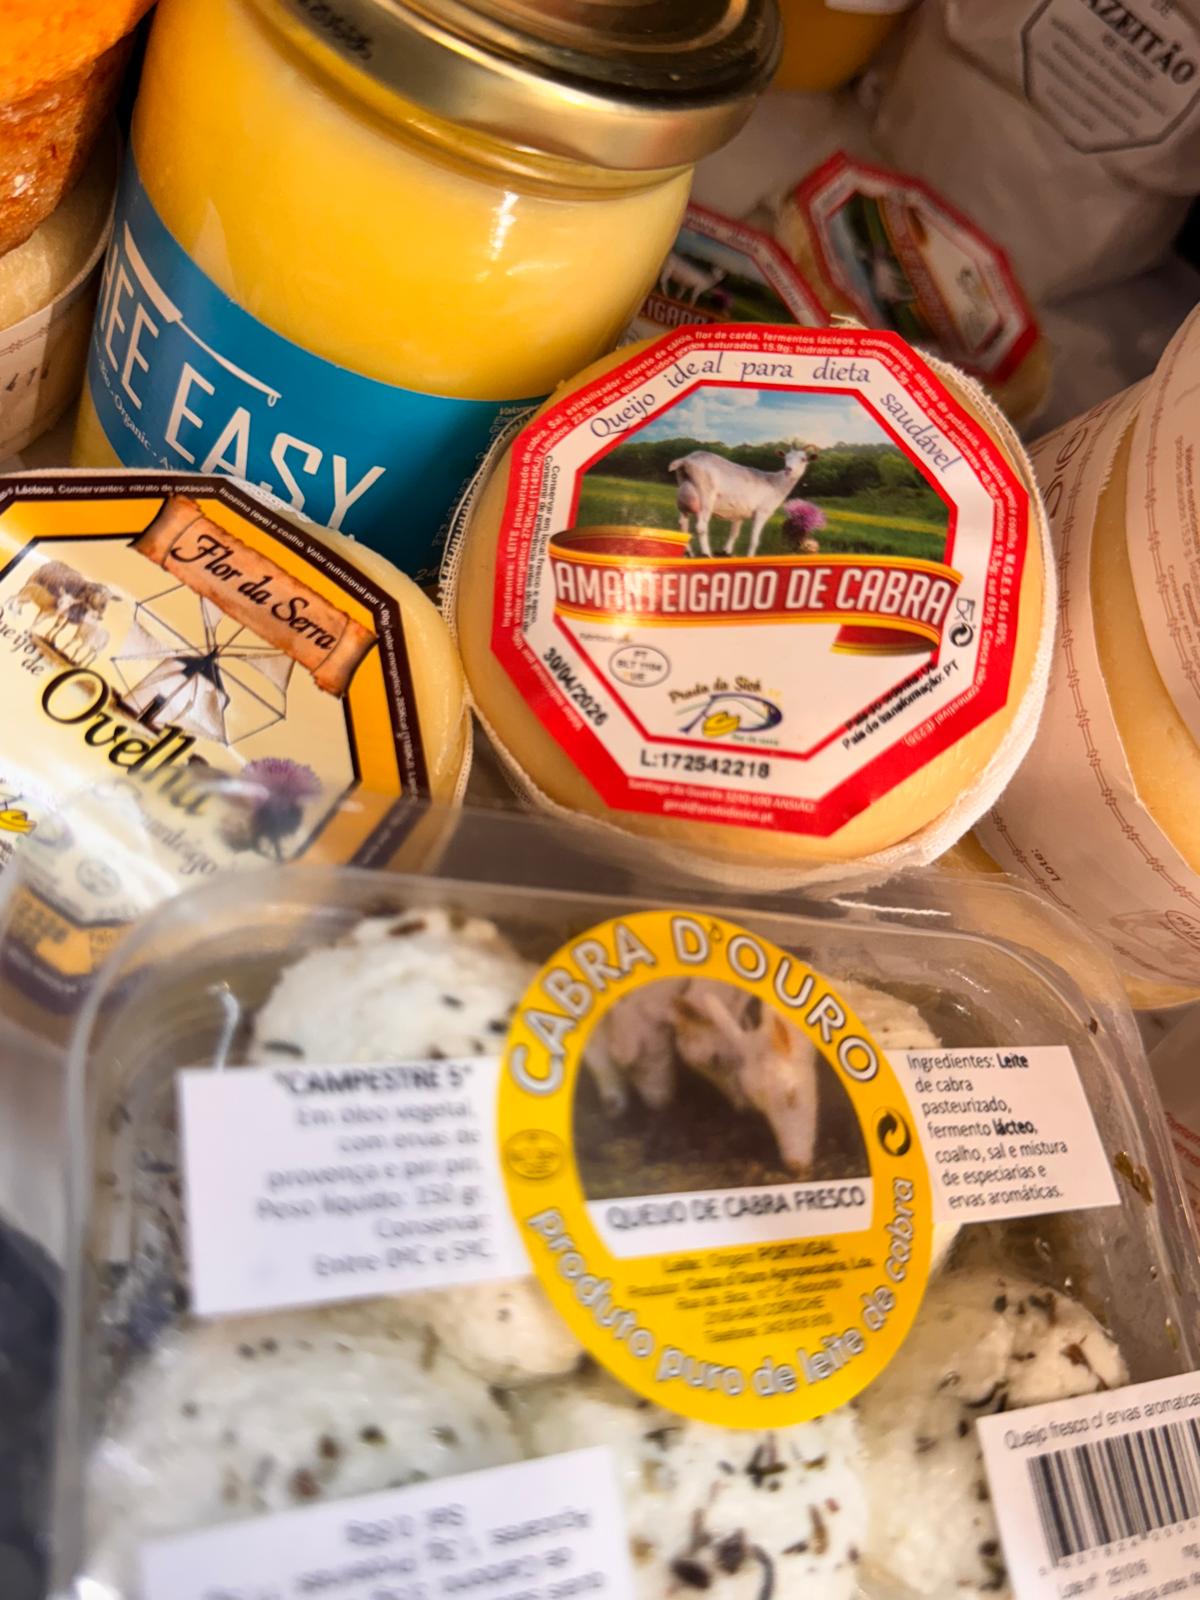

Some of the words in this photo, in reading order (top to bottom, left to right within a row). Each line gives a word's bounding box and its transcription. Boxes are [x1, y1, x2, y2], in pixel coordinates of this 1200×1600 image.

[602, 391, 621, 406] dos
[620, 374, 647, 395] quais
[113, 394, 151, 450] Organic
[590, 392, 656, 438] Queijo
[663, 352, 724, 389] ideal
[741, 360, 794, 382] para
[812, 356, 872, 383] dieta
[880, 392, 962, 474] saudável
[165, 362, 386, 531] EASY
[506, 530, 520, 558] LEITE
[717, 331, 727, 340] de
[763, 331, 814, 344] fermentos
[541, 455, 554, 501] Consumir
[545, 465, 561, 515] Conservar
[58, 483, 125, 495] Conservantes:
[129, 484, 159, 493] nitrato
[161, 484, 173, 493] de
[306, 545, 327, 565] Valor
[326, 562, 367, 597] nutricional
[364, 591, 380, 606] por
[539, 532, 551, 557] local
[171, 534, 242, 582] Flor
[238, 575, 273, 605] da
[271, 596, 337, 650] Serra
[533, 557, 546, 589] fresco
[556, 562, 777, 613] AMANTEIGADO
[785, 568, 833, 611] DE
[836, 568, 951, 625] CABRA
[1167, 564, 1186, 622] Conservar
[21, 655, 45, 678] de
[543, 647, 608, 726] 30/04/2026
[943, 659, 959, 677] PT
[41, 667, 213, 817] Ovelha
[640, 749, 771, 779] L:172542218
[1031, 847, 1062, 883] Lote:
[510, 921, 656, 1095] CABRA
[907, 1054, 996, 1073] Ingredientes:
[997, 1053, 1029, 1069] Leite
[915, 1077, 933, 1093] de
[936, 1077, 974, 1092] cabra
[921, 1098, 1012, 1117] pasteurizado,
[928, 1120, 991, 1139] fermento
[992, 1117, 1038, 1136] lácteo,
[935, 1145, 986, 1165] coalho,
[987, 1143, 1005, 1159] sal
[1008, 1145, 1017, 1158] e
[1020, 1139, 1068, 1156] mistura
[942, 1171, 960, 1187] de
[962, 1165, 1035, 1187] especiarias
[1037, 1166, 1047, 1177] e
[948, 1193, 986, 1210] ervas
[988, 1185, 1064, 1206] aromáticas.
[608, 1199, 686, 1231] QUEIJO
[692, 1197, 721, 1221] DE
[727, 1192, 791, 1220] CABRA
[794, 1186, 866, 1211] FRESCO
[753, 1356, 796, 1398] de
[796, 1326, 865, 1385] leite
[861, 1283, 896, 1332] de
[884, 1178, 915, 1284] cabra
[1003, 1426, 1048, 1452] Queijo
[1048, 1418, 1091, 1437] fresco
[1106, 1406, 1141, 1424] ervas
